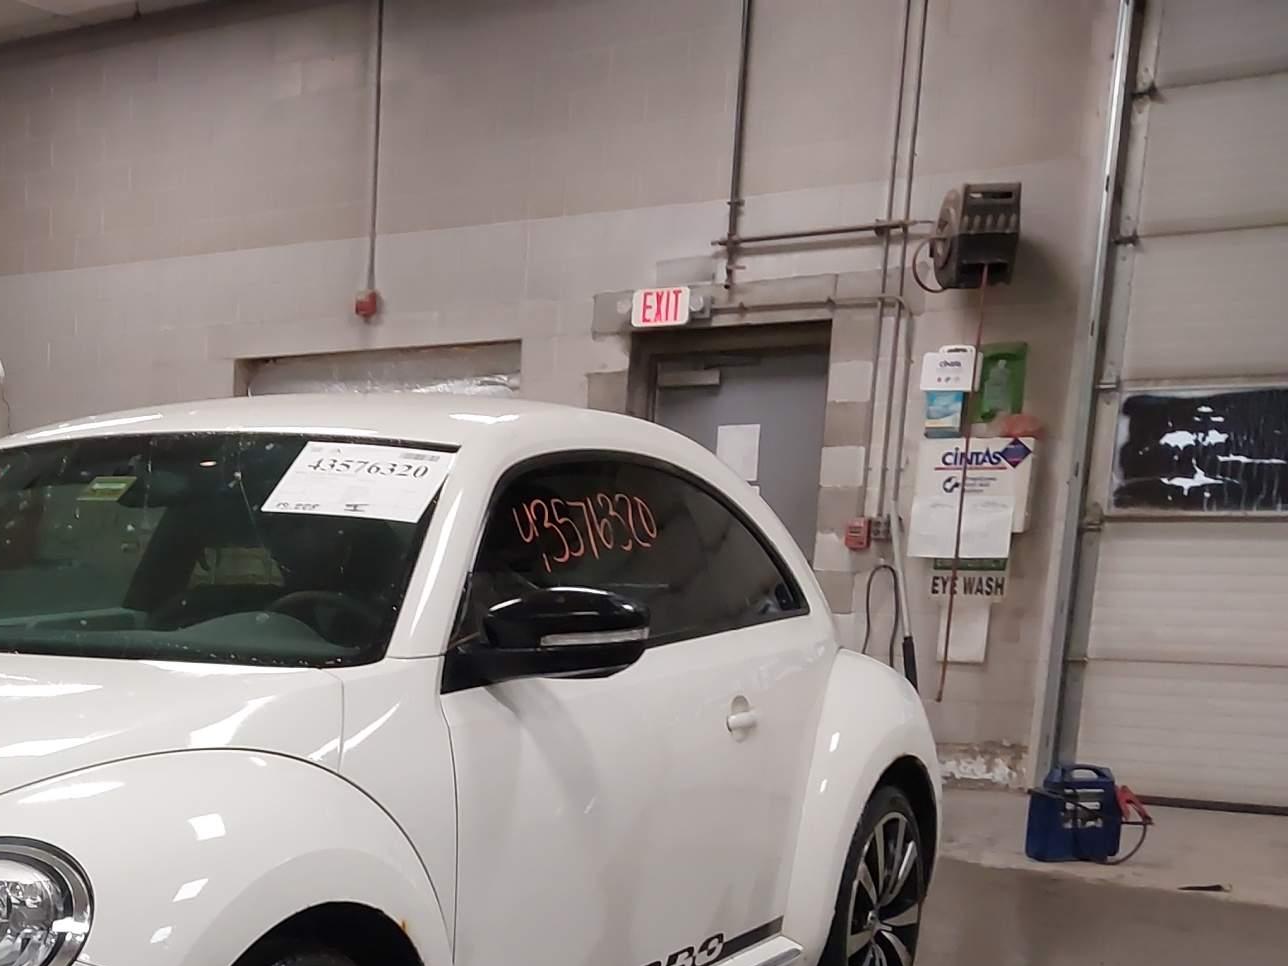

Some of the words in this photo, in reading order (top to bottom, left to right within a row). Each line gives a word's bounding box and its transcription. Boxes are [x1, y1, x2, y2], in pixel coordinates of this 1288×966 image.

[642, 290, 682, 322] EXIT
[308, 457, 429, 479] 43576320
[931, 576, 958, 595] EYE
[963, 576, 1006, 596] WASH
